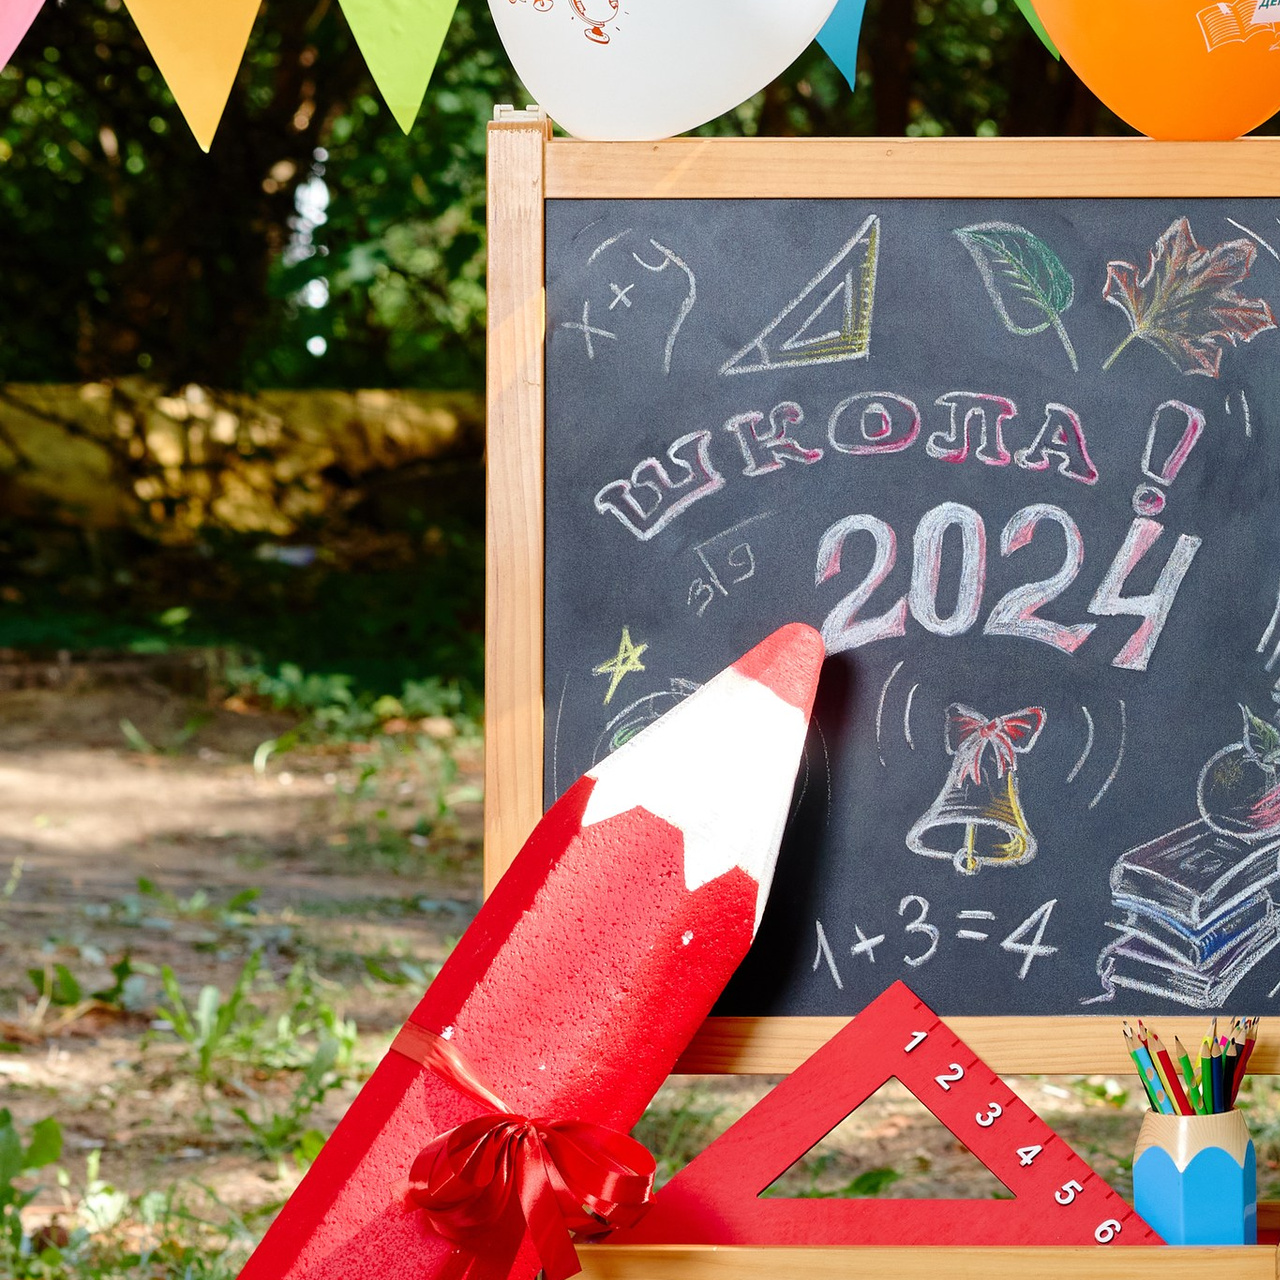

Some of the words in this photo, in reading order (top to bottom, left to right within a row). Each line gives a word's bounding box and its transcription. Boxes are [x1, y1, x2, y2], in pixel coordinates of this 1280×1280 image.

[815, 500, 1202, 671] 2024
[901, 1029, 929, 1056] 1
[933, 1062, 966, 1093] 2
[974, 1101, 1005, 1130] 3
[1015, 1142, 1045, 1170] 4
[1053, 1178, 1084, 1208] 5
[1093, 1217, 1124, 1246] 6
